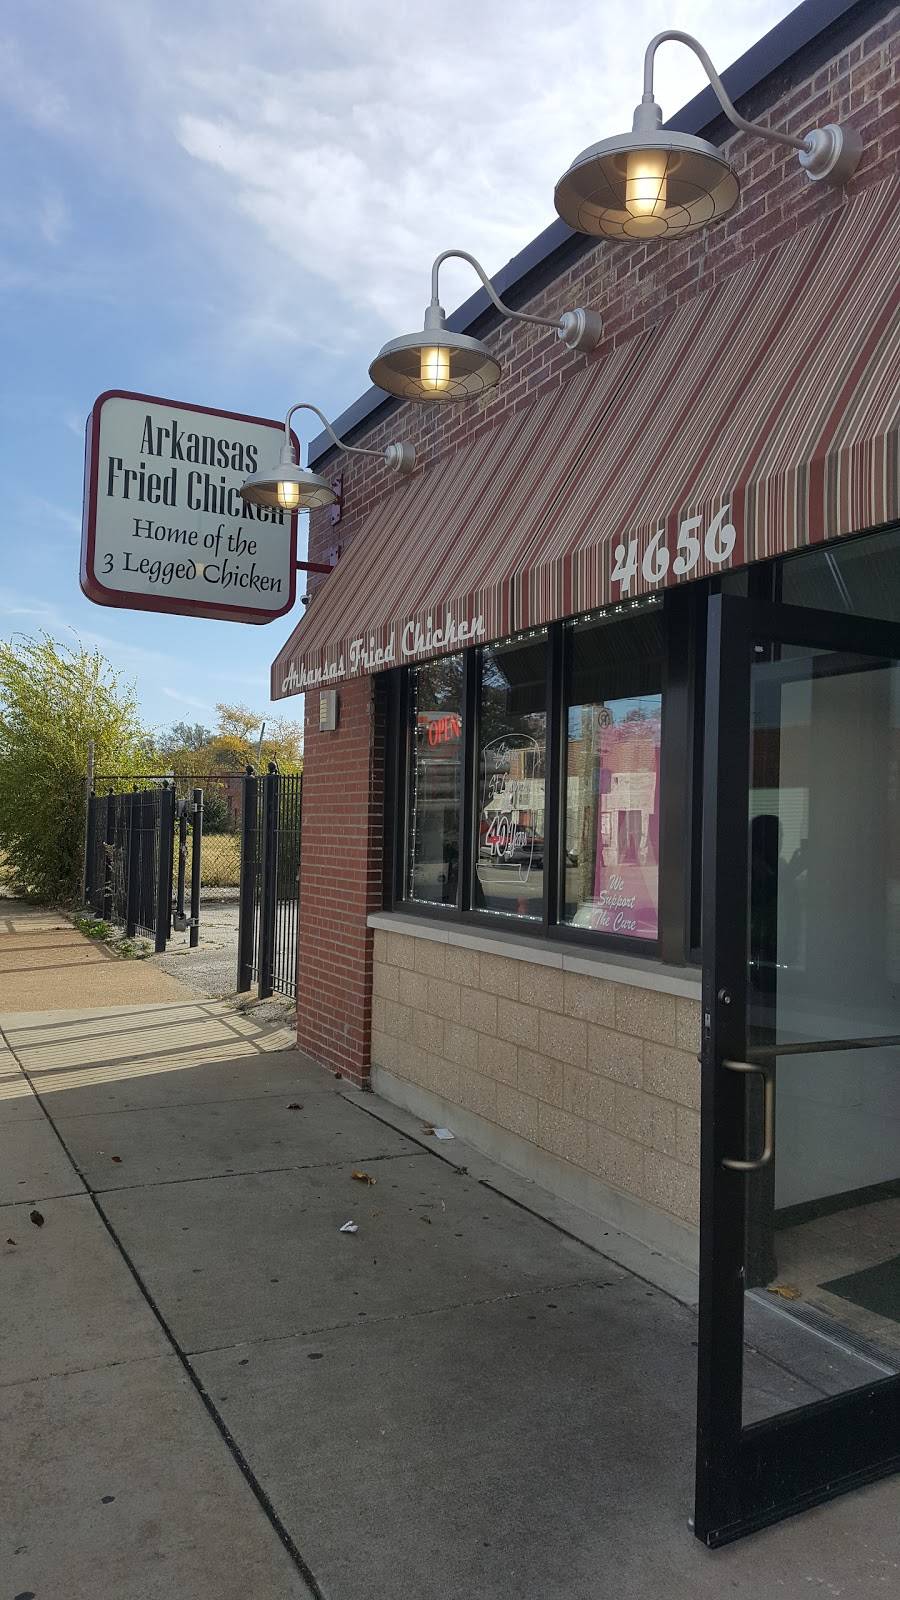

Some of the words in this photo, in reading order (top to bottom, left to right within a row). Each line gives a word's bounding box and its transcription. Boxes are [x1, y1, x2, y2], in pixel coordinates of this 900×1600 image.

[140, 415, 258, 474] Arkansas
[107, 456, 177, 507] Fried
[132, 518, 198, 546] Home
[203, 524, 225, 557] of
[228, 527, 257, 557] the
[610, 503, 737, 592] 4656
[102, 553, 114, 574] 3
[122, 551, 197, 585] Legged
[202, 558, 282, 593] Chicken
[281, 654, 346, 693] Arkansas
[350, 631, 395, 672] Fried
[401, 612, 486, 656] Chicken
[428, 714, 462, 746] OPEN
[598, 889, 636, 910] Support
[609, 873, 625, 890] We
[593, 908, 610, 928] The
[613, 911, 636, 932] Cure
